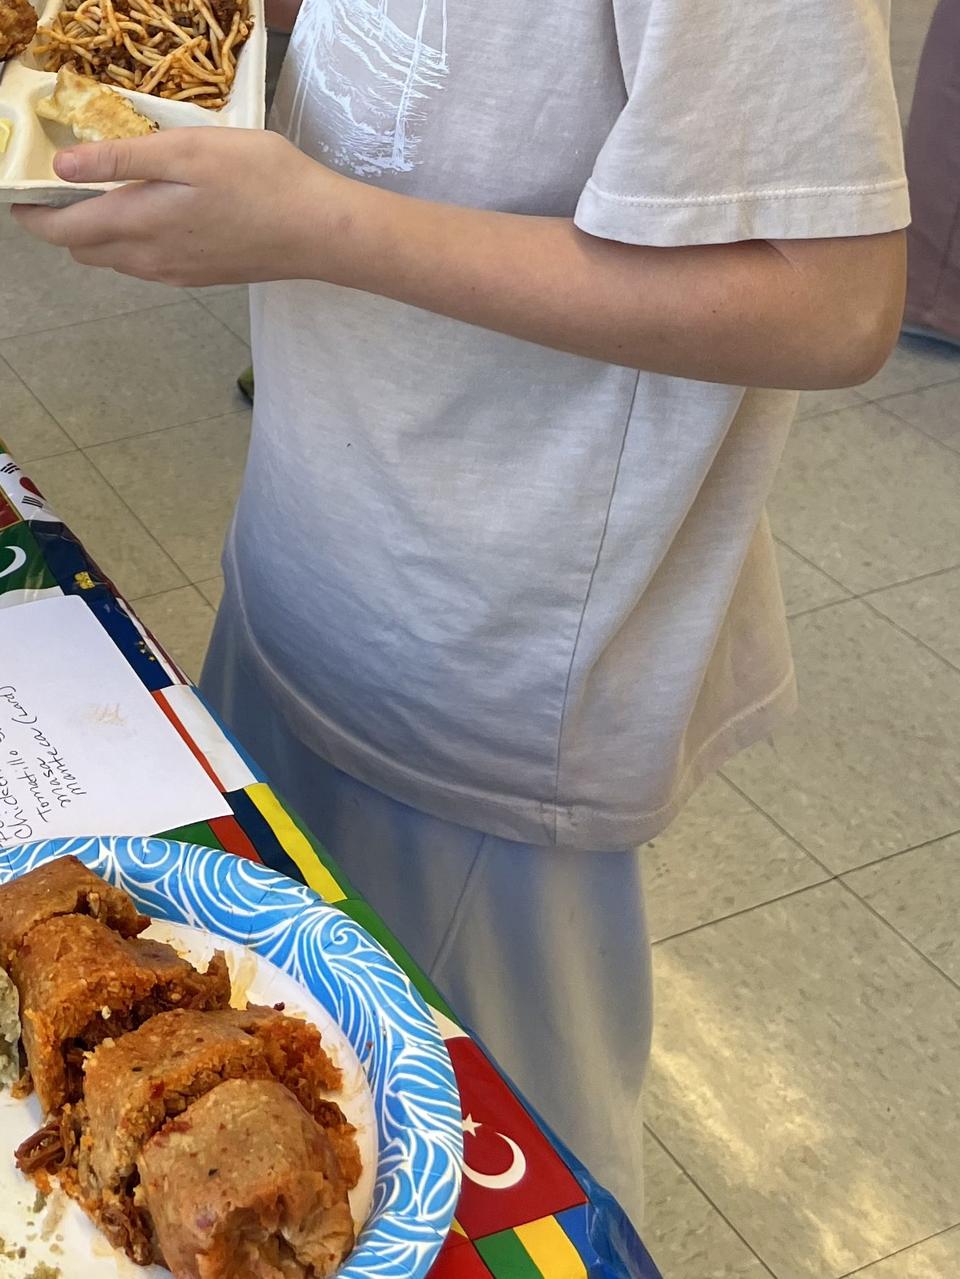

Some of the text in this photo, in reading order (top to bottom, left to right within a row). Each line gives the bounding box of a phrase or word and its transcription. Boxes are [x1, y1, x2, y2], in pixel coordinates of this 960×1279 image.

[8, 750, 53, 823] Tomatillo
[31, 727, 87, 796] manteca
[36, 757, 72, 808] masa
